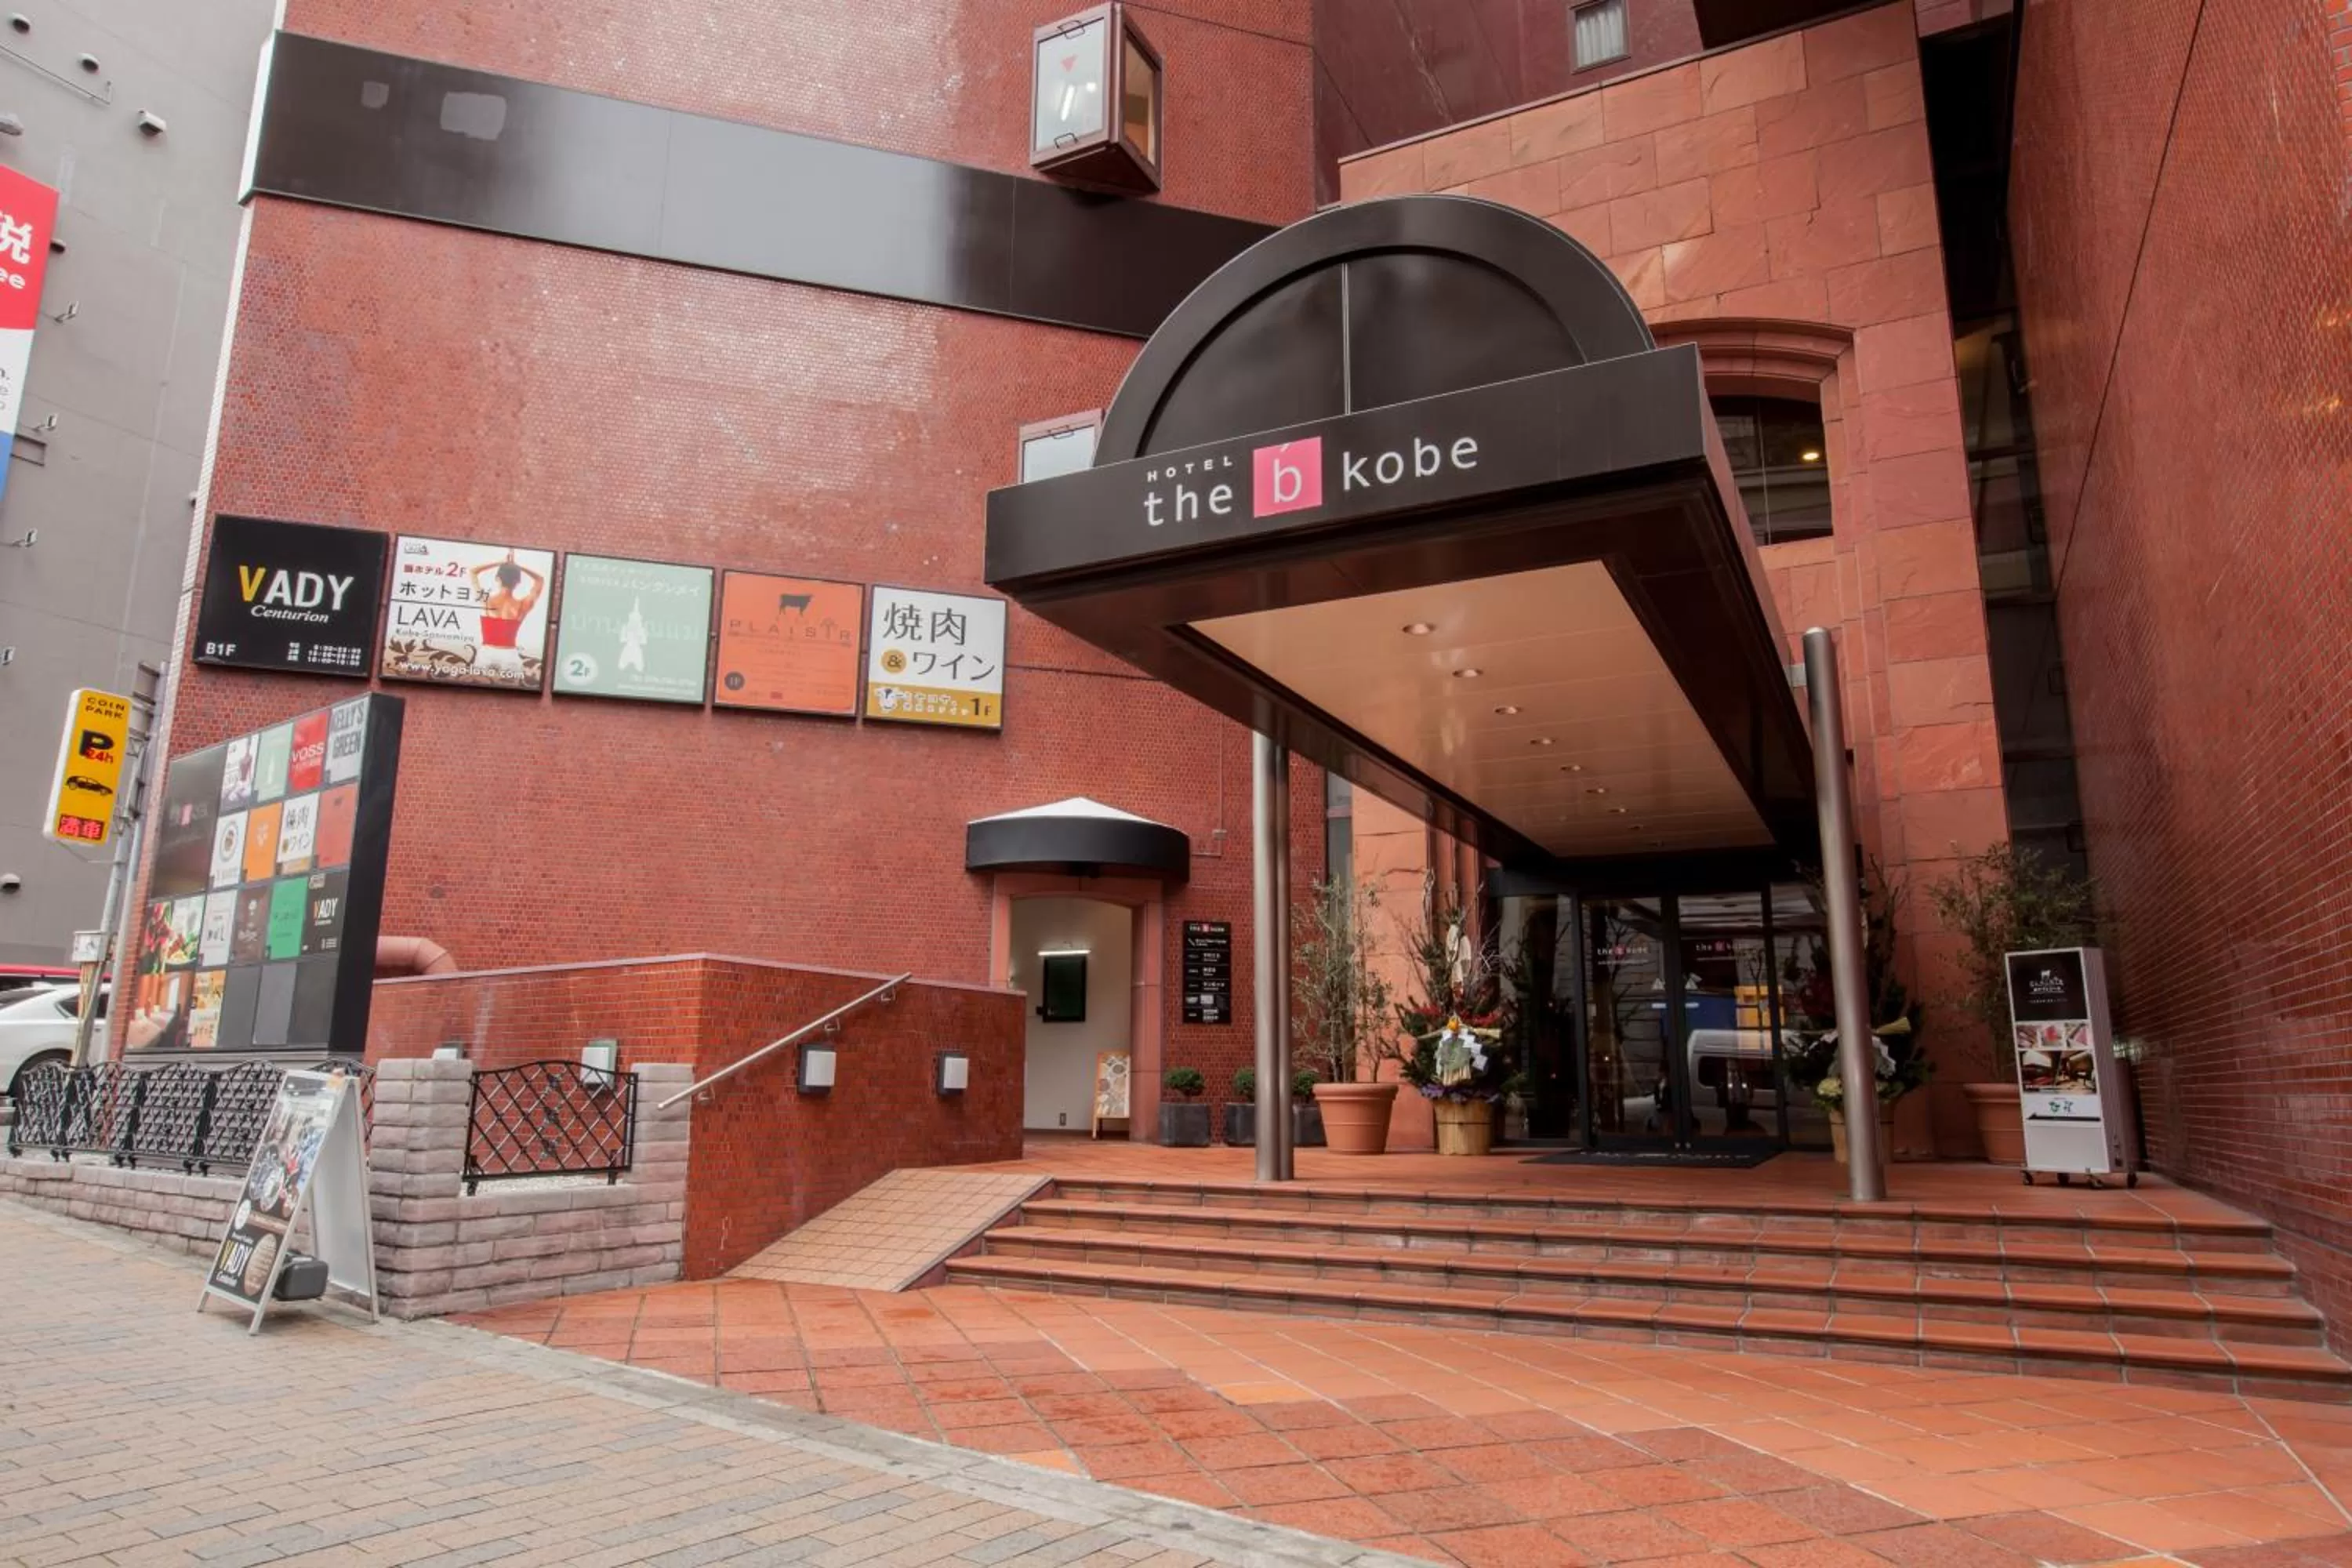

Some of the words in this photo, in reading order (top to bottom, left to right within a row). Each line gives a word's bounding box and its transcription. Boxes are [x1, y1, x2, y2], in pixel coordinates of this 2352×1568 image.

[1147, 456, 1233, 482] HOTEL
[1144, 483, 1233, 527] the
[1343, 437, 1478, 491] kobe
[238, 564, 354, 611] VADY
[399, 581, 490, 603] ホットヨガ
[250, 604, 328, 623] Centurion
[397, 605, 461, 630] LAVA
[882, 601, 967, 646] 焼肉
[205, 642, 236, 656] B1F
[887, 655, 902, 669] &
[913, 652, 996, 681] ワイン
[85, 706, 123, 719] PARK
[87, 697, 125, 712] COIN
[79, 729, 114, 757] P
[292, 743, 325, 763] VOSS
[86, 748, 114, 764] 24h
